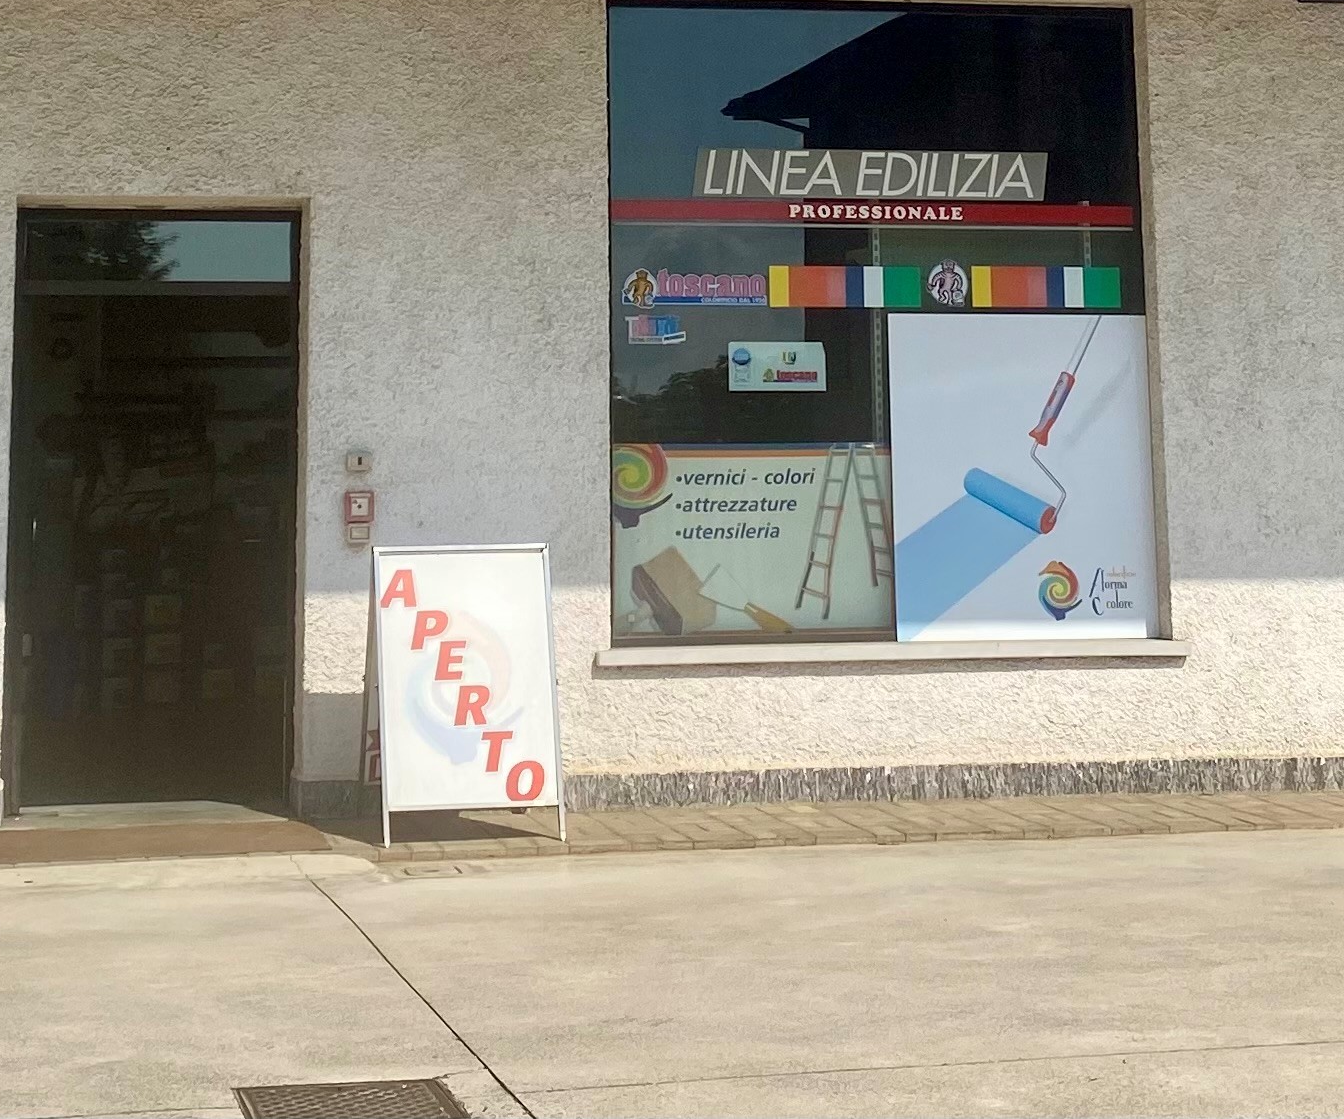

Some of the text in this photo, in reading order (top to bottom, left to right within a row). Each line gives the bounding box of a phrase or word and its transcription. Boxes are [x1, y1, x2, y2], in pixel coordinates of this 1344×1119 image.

[702, 148, 1035, 199] LINEA EDILIZIA
[788, 203, 964, 221] PROFESSIONALE
[656, 268, 767, 298] toscano
[683, 468, 746, 486] vernici
[764, 467, 816, 485] colori
[682, 497, 798, 513] attrezzature
[682, 522, 781, 540] utensileria
[379, 568, 546, 802] APERTO
